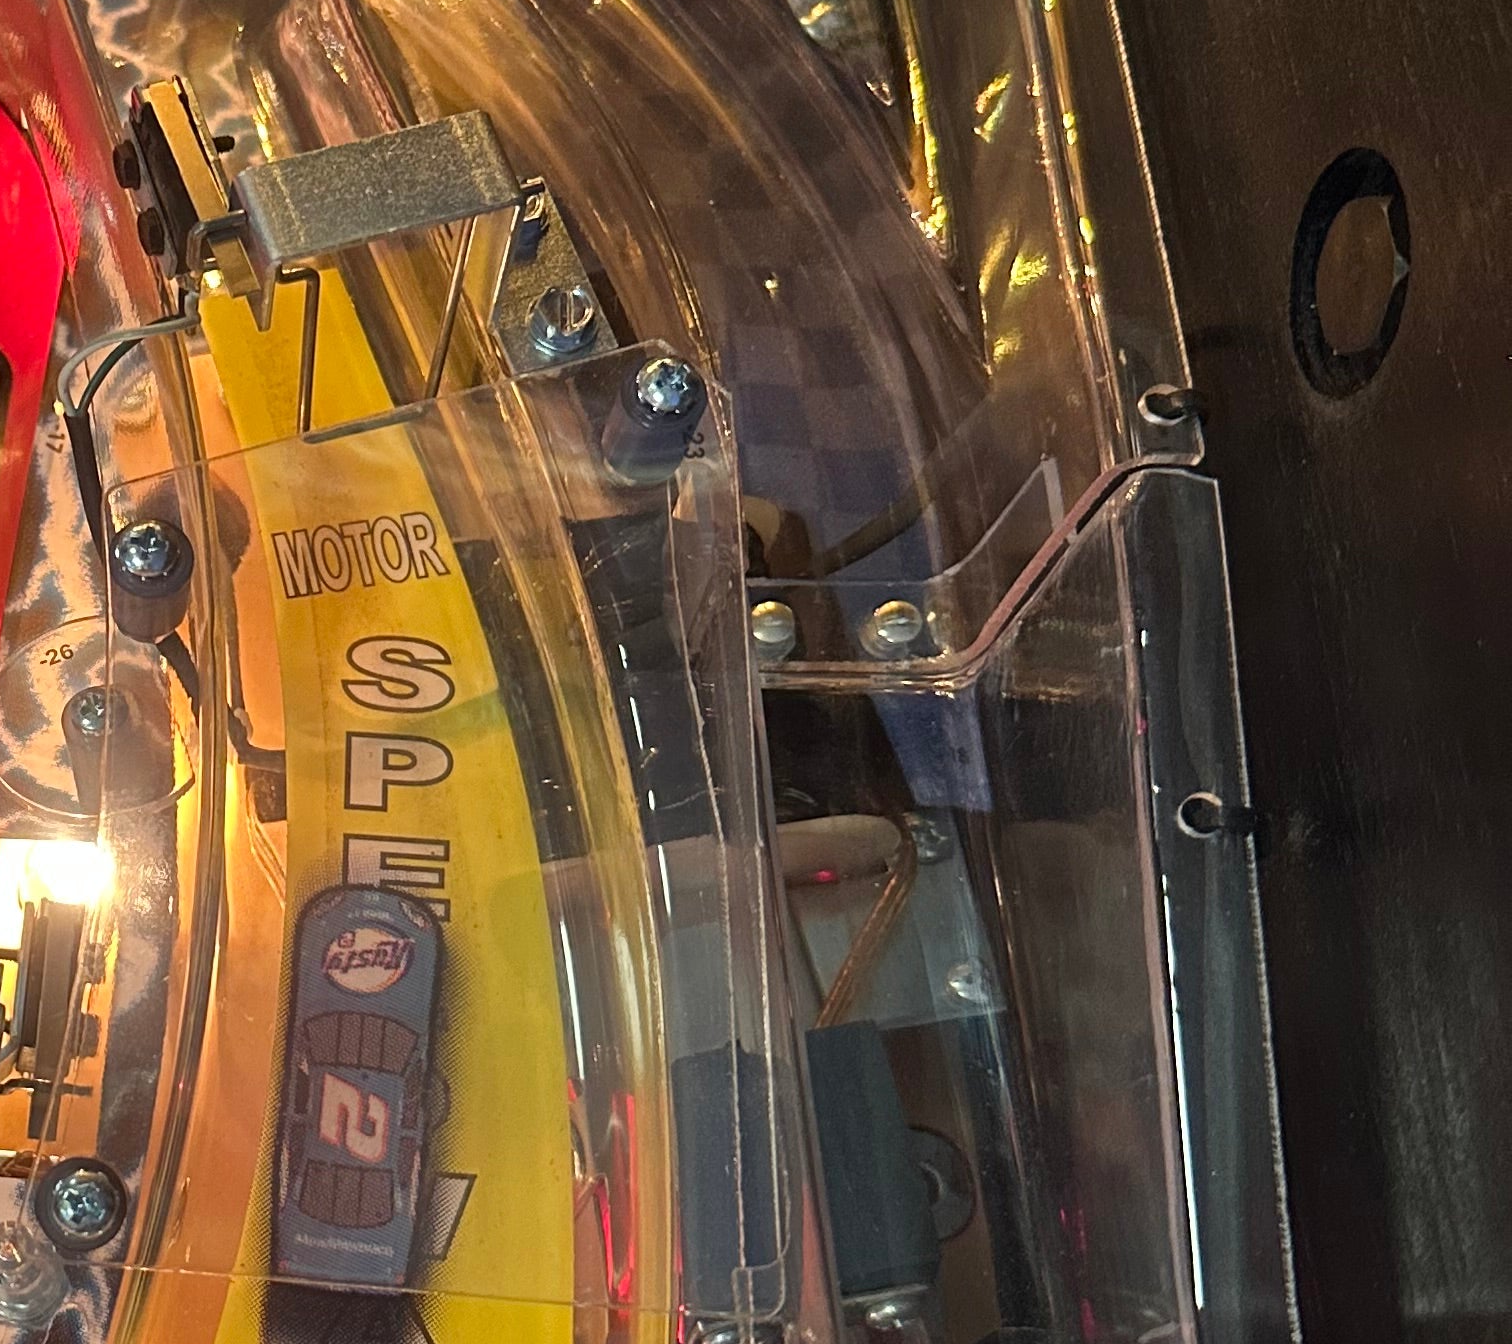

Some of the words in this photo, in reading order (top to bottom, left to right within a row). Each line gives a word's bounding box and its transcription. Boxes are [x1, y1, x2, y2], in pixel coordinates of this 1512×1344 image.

[272, 511, 451, 599] MOTOR
[39, 644, 75, 666] -26
[319, 1078, 390, 1165] 2
